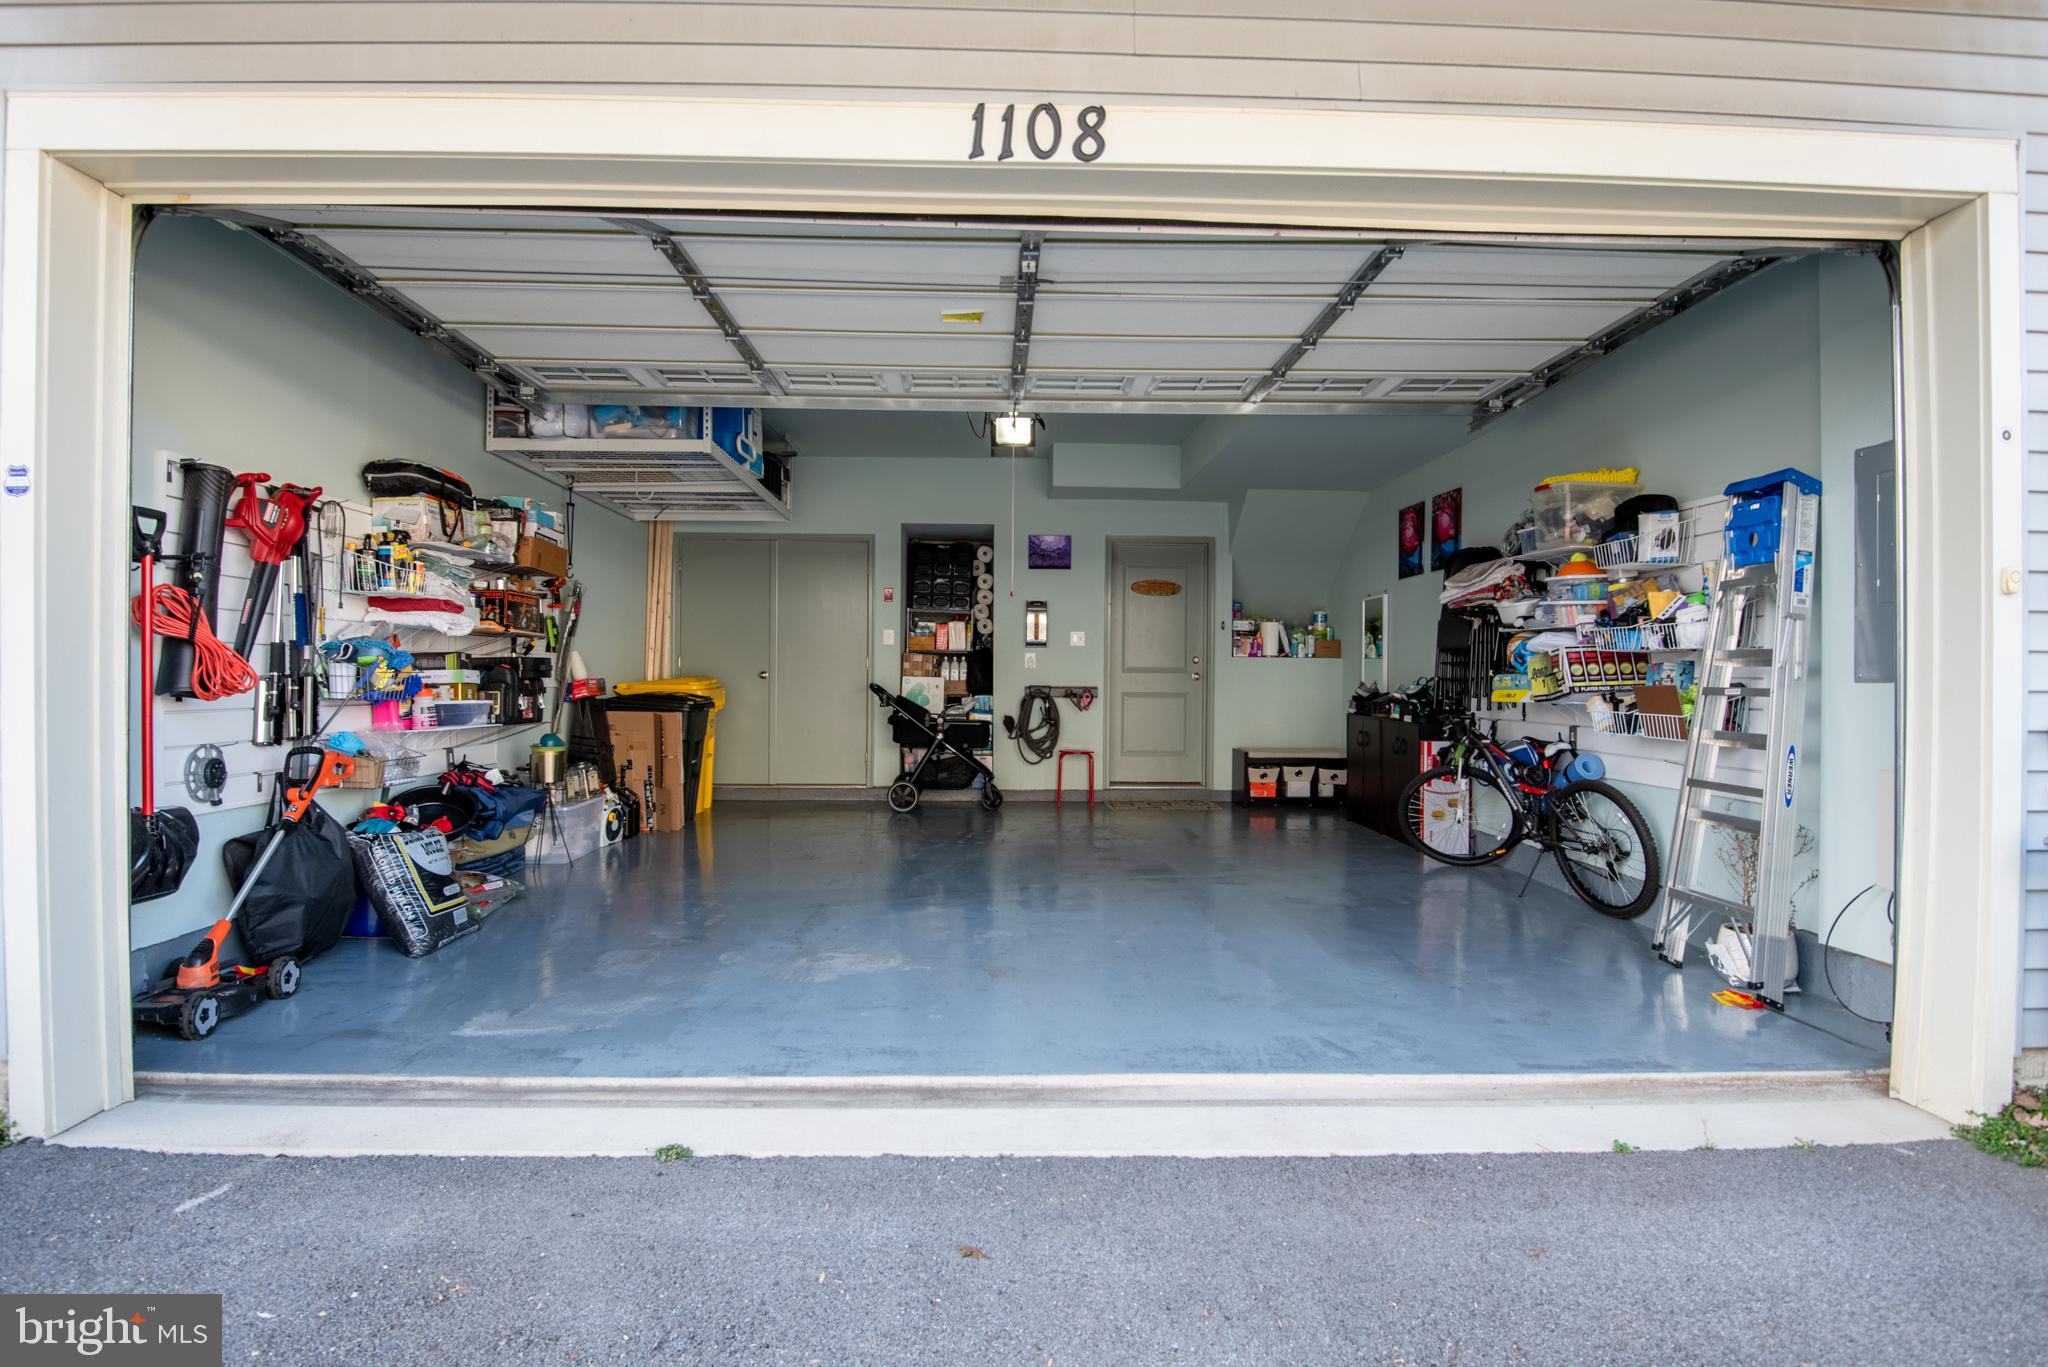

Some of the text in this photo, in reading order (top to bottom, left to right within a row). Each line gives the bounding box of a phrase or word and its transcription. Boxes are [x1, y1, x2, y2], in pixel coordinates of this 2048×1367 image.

[968, 102, 1106, 162] 1108
[1786, 757, 1795, 795] WERNER
[371, 840, 396, 886] COLORED
